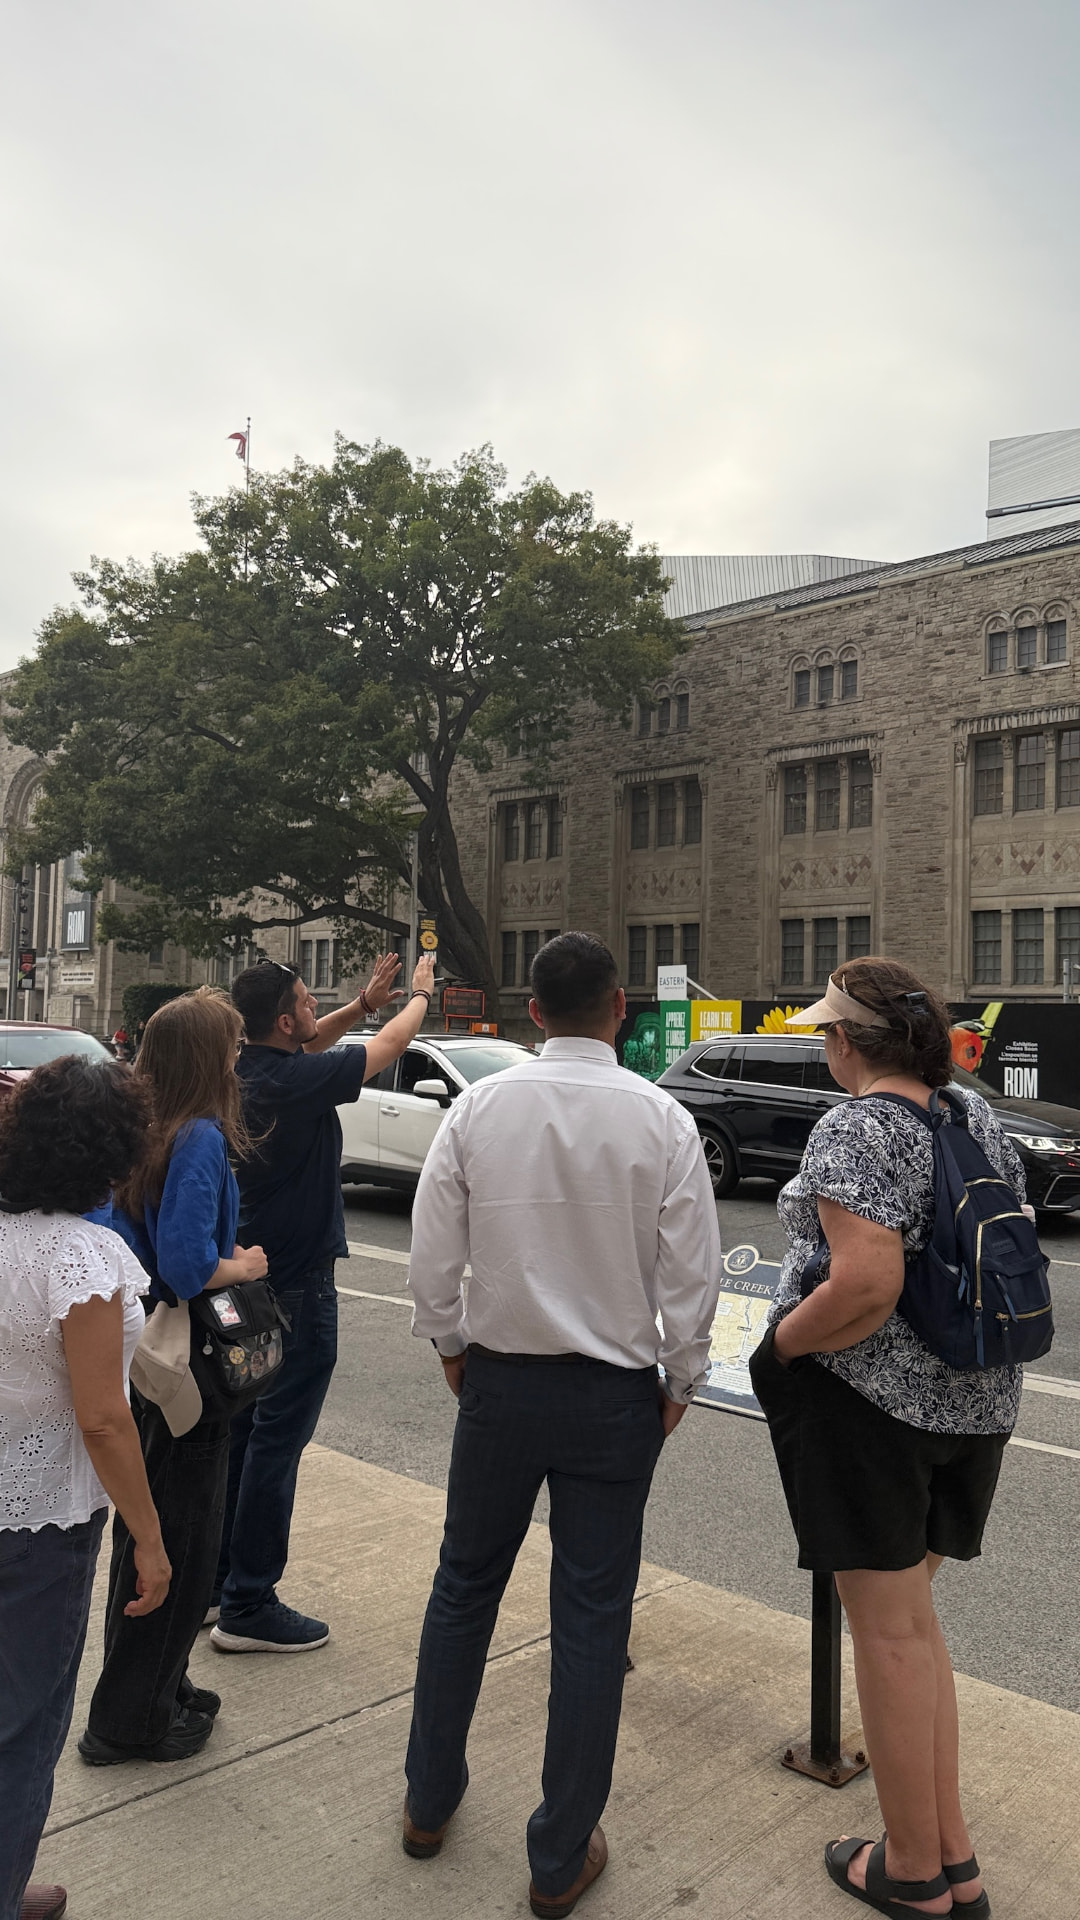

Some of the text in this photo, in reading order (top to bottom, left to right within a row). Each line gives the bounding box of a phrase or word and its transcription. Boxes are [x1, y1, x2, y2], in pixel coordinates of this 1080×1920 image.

[67, 910, 85, 944] ROM
[659, 976, 685, 985] EASTERN
[666, 1012, 686, 1028] APPRENEZ
[700, 1011, 733, 1028] LEARN THE
[1004, 1066, 1038, 1099] ROM
[733, 1280, 774, 1295] CREEK
